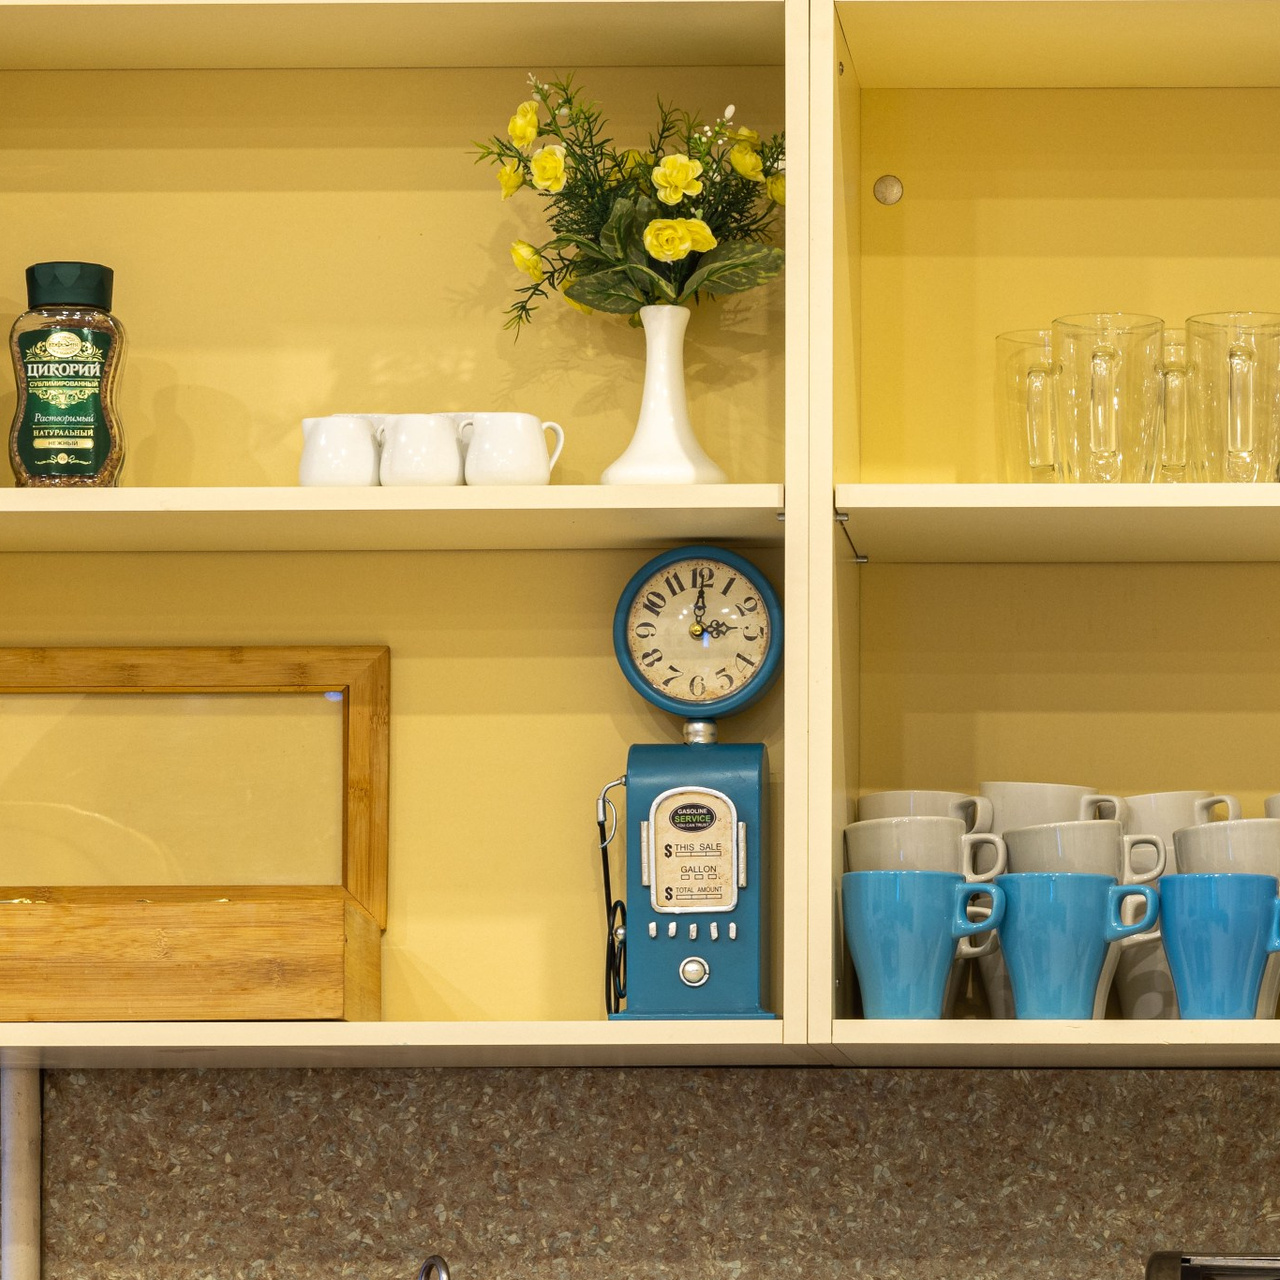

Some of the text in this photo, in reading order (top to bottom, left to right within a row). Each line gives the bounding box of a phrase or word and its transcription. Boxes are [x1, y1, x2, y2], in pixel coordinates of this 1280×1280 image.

[27, 362, 101, 378] ЦИКОРИЙ
[35, 413, 94, 424] Растворимый
[664, 572, 686, 597] 11
[691, 567, 714, 588] 12
[721, 577, 736, 596] 1
[643, 591, 666, 617] 10
[735, 597, 757, 617] 2
[635, 622, 656, 639] 9
[743, 625, 764, 641] 3
[642, 649, 662, 668] 8
[735, 652, 755, 673] 4
[662, 665, 684, 687] 7
[689, 675, 706, 696] 6
[715, 668, 734, 690] 5
[665, 843, 672, 858] $
[681, 865, 717, 873] GALLON
[665, 886, 673, 901] $
